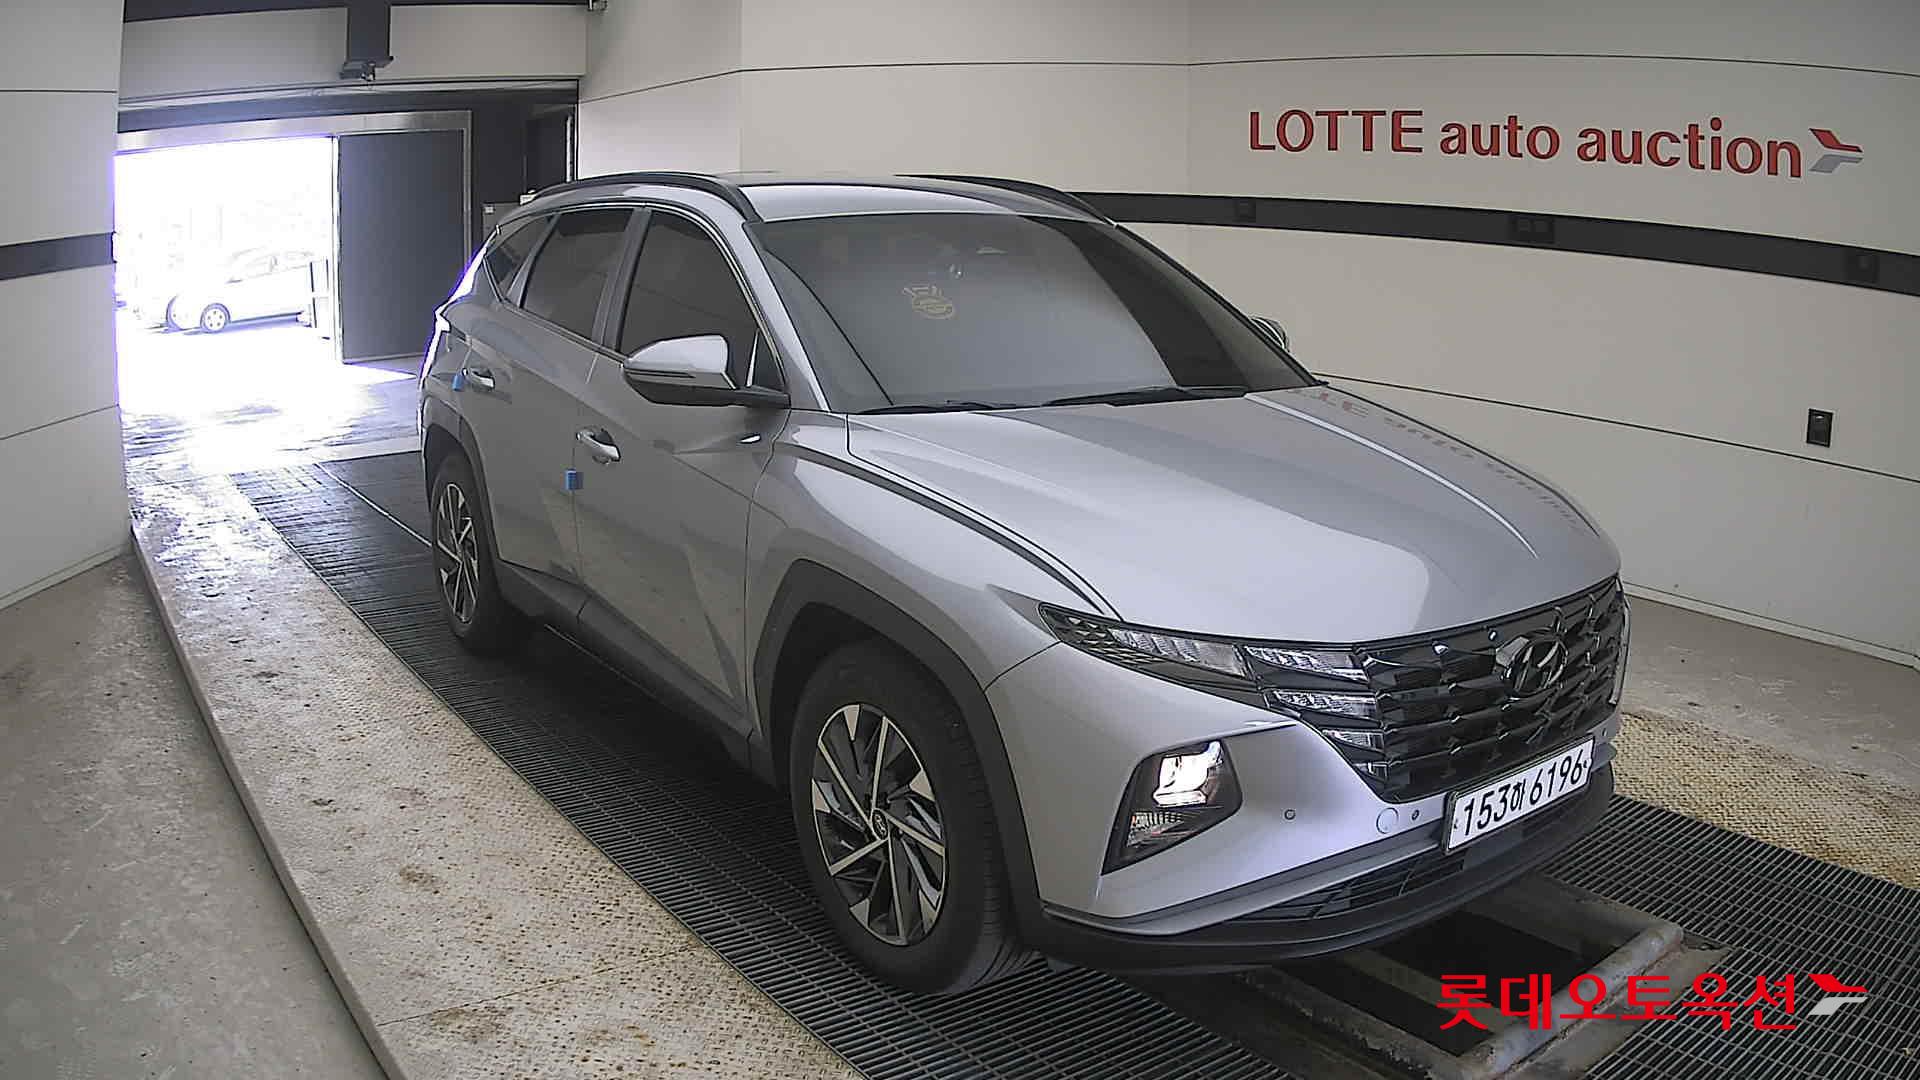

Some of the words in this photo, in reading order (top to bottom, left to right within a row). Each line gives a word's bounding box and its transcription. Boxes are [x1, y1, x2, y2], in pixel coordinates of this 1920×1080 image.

[1248, 110, 1423, 153] LOTTE
[1440, 116, 1561, 161] auto
[1576, 118, 1802, 178] auction
